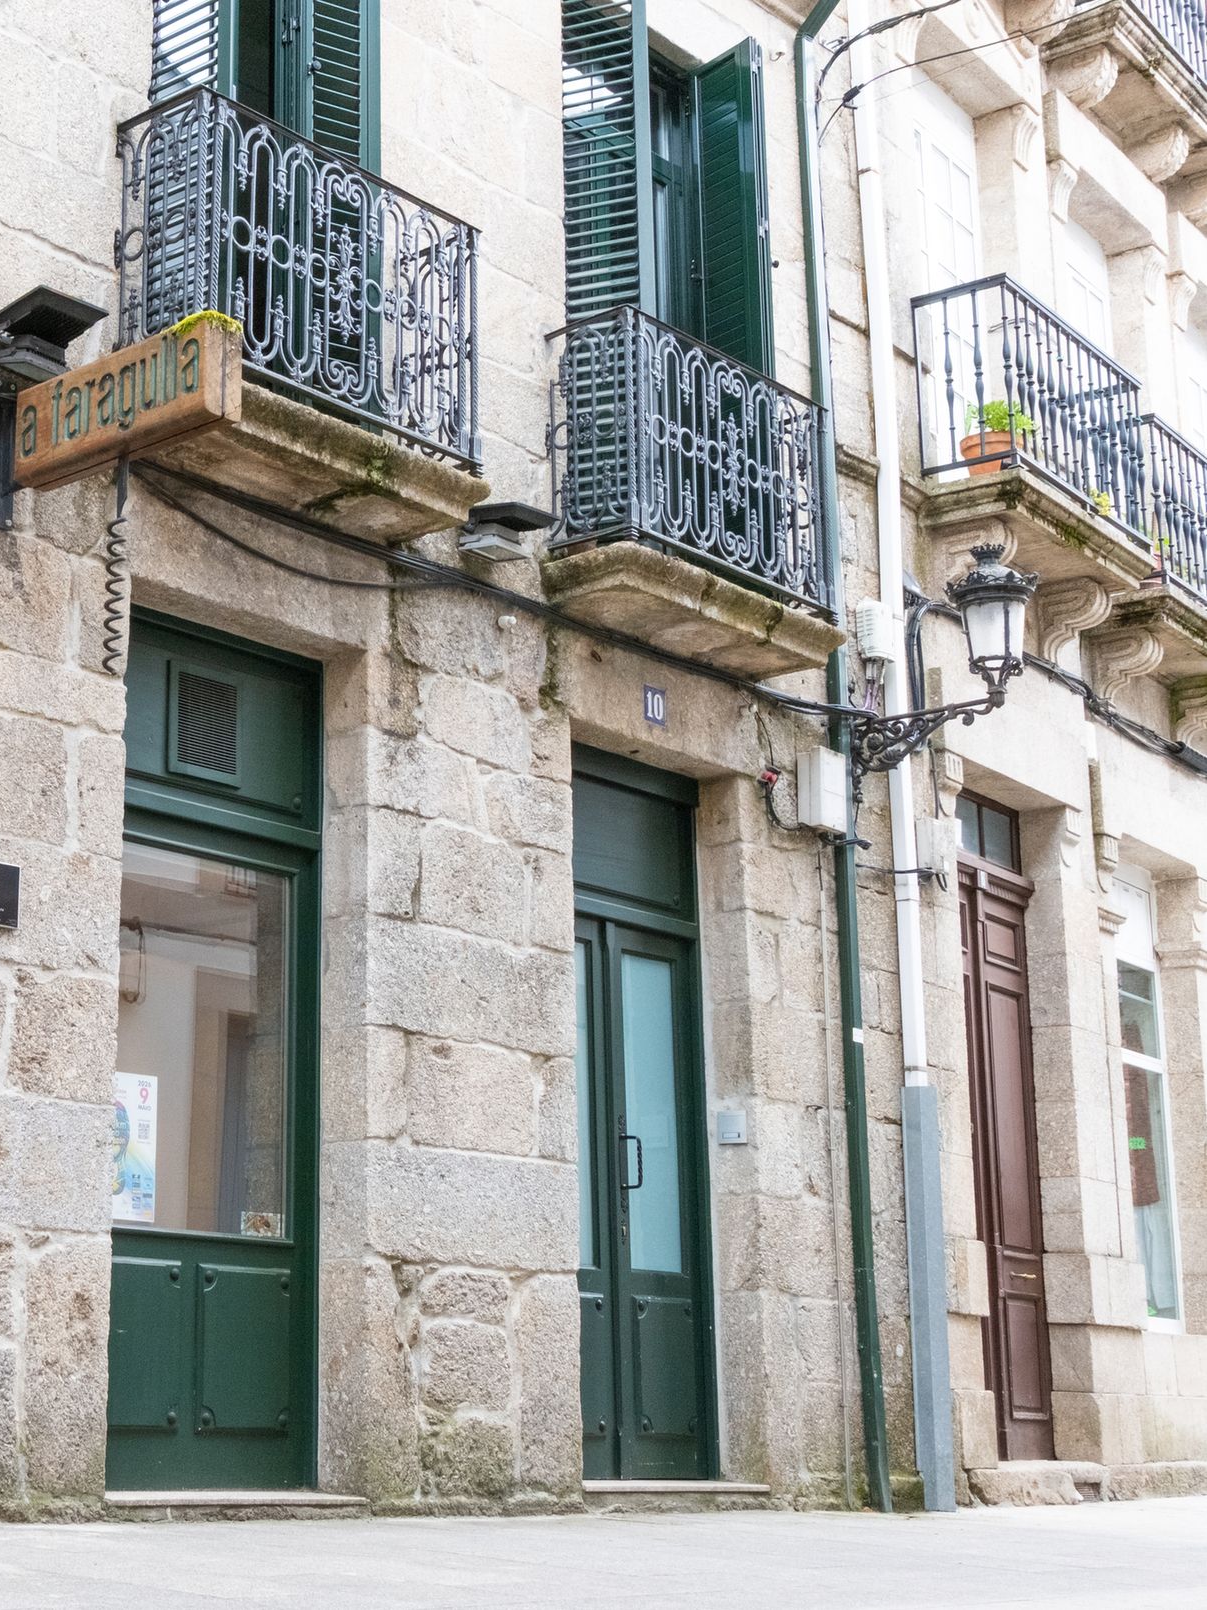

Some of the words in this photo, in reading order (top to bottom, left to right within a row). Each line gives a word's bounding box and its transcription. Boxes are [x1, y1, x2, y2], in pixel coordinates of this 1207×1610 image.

[20, 404, 38, 457] a
[51, 332, 200, 447] faragulla
[646, 690, 664, 720] 10
[139, 1088, 149, 1104] 9
